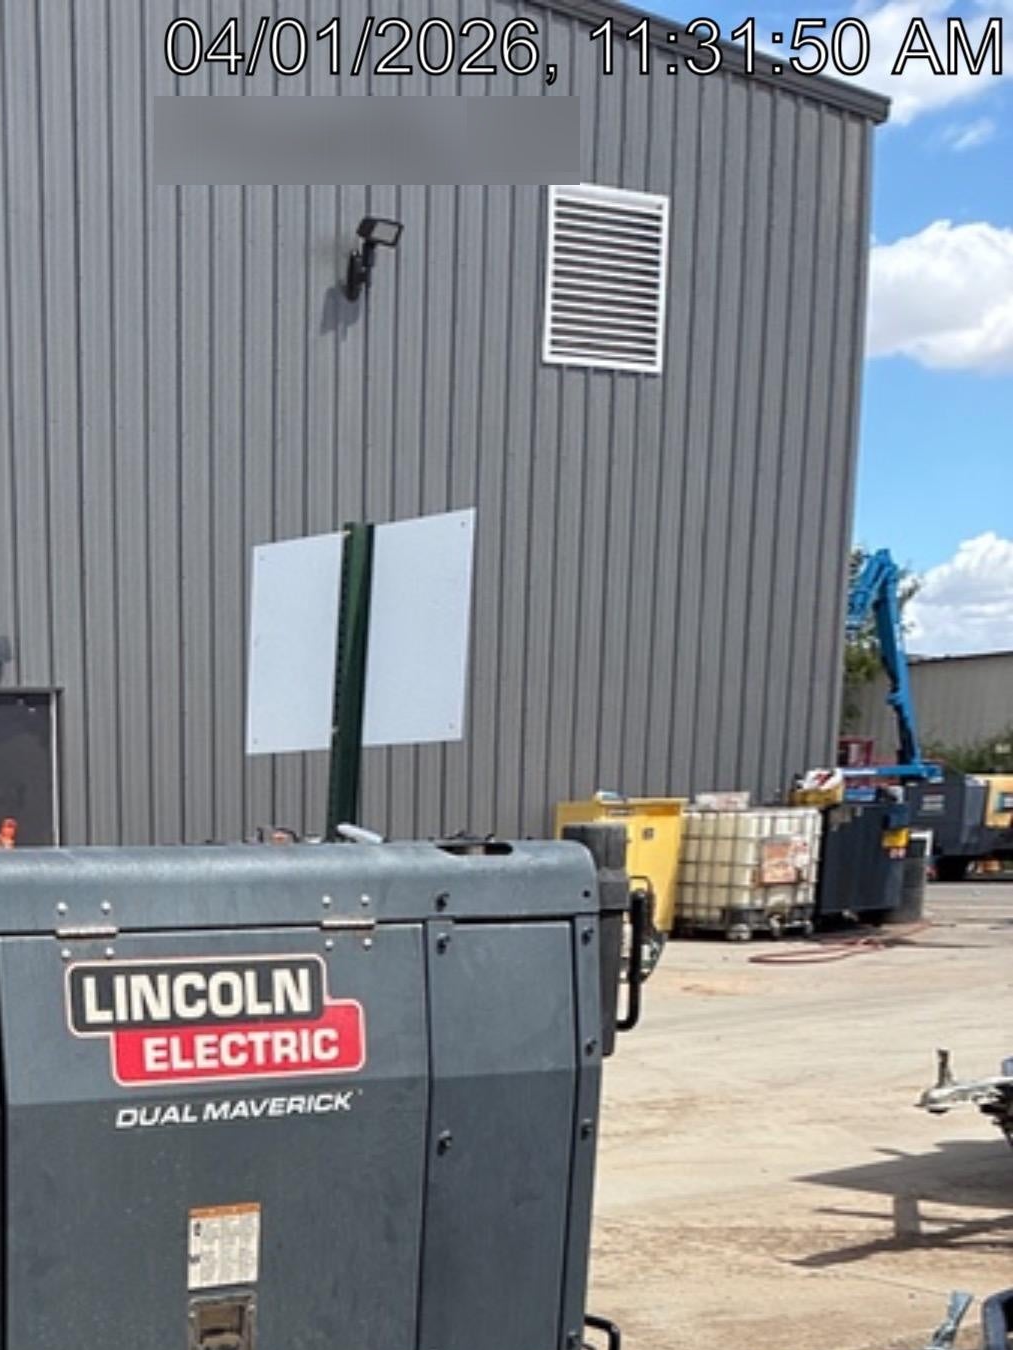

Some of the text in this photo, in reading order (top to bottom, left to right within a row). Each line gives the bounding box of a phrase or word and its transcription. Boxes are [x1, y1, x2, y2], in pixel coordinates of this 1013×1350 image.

[83, 968, 310, 1023] LINCOLN
[144, 1028, 339, 1071] ELECTRIC
[115, 1091, 353, 1128] DUAL MAVERICK
